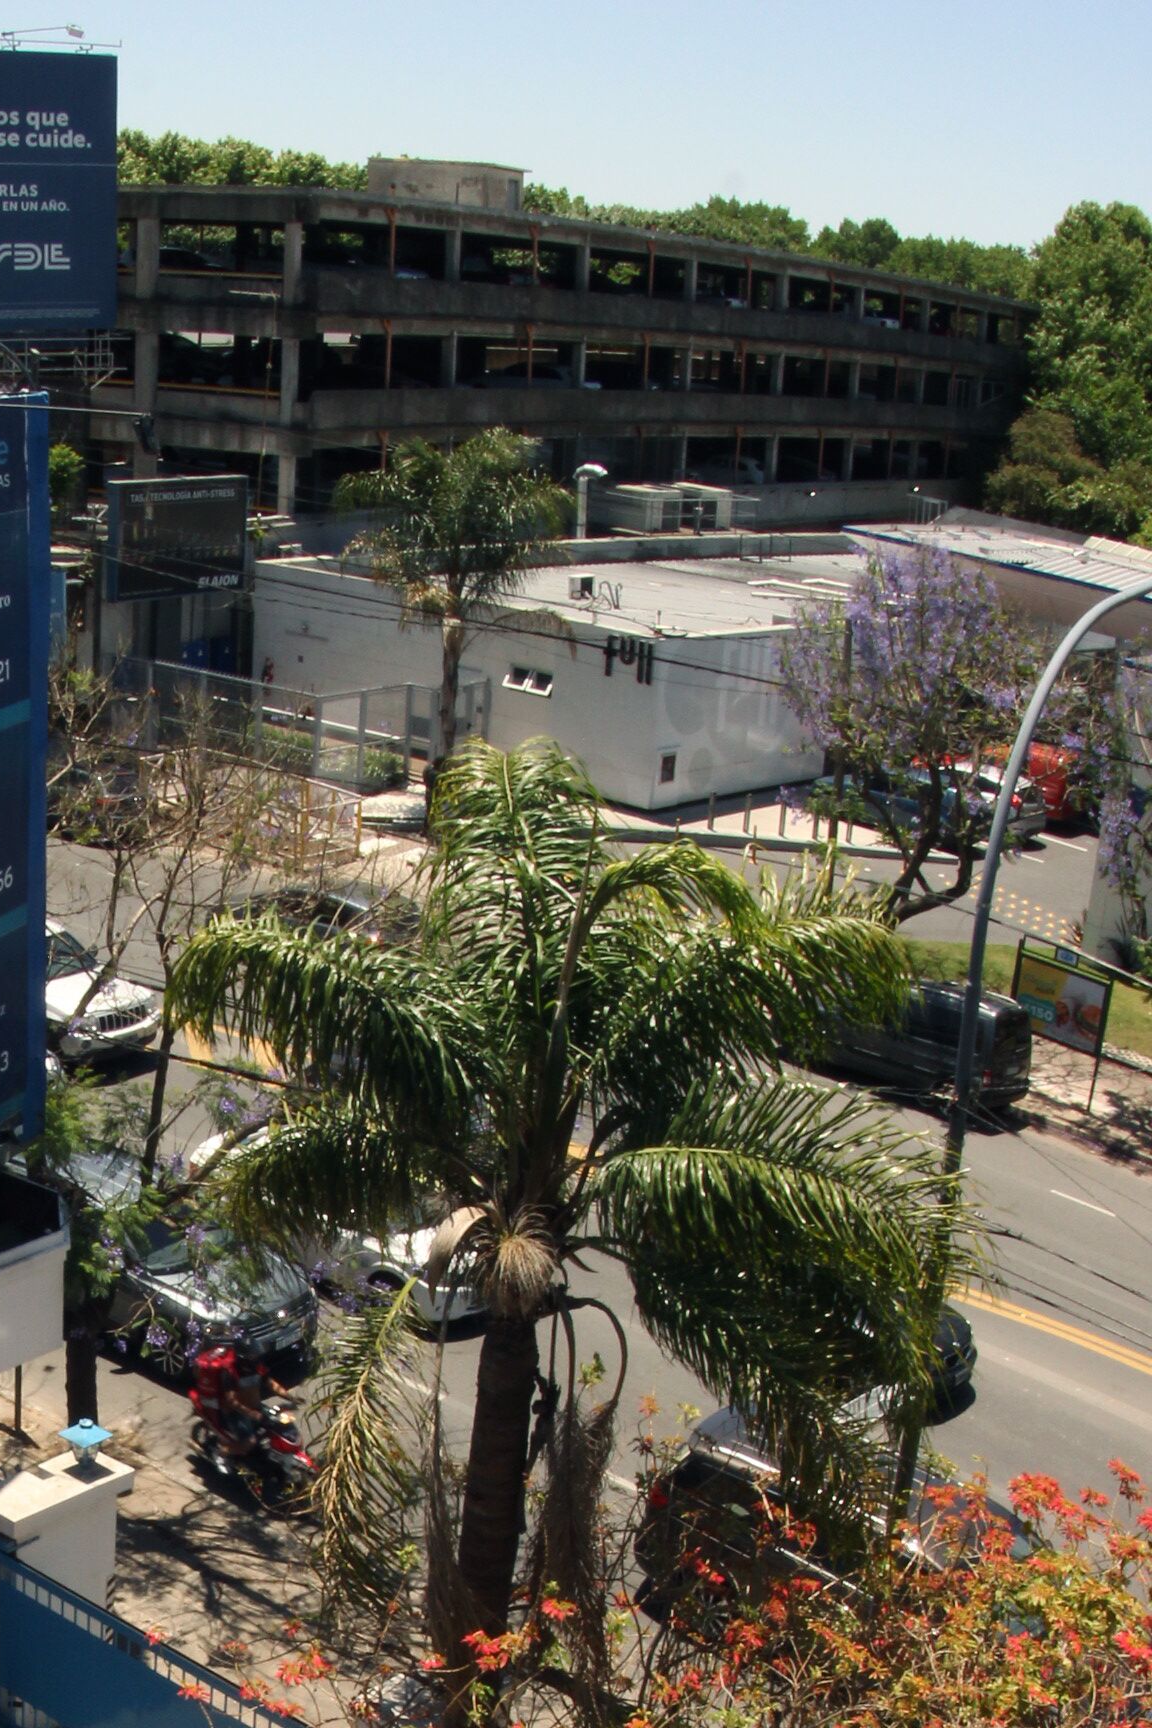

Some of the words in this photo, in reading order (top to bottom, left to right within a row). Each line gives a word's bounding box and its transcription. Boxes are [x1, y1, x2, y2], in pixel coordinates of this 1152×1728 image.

[26, 110, 69, 131] que
[25, 129, 92, 149] cuide.
[2, 201, 18, 212] EN
[21, 201, 38, 212] UN
[40, 199, 70, 213] AÑO.
[198, 574, 239, 588] ELAION
